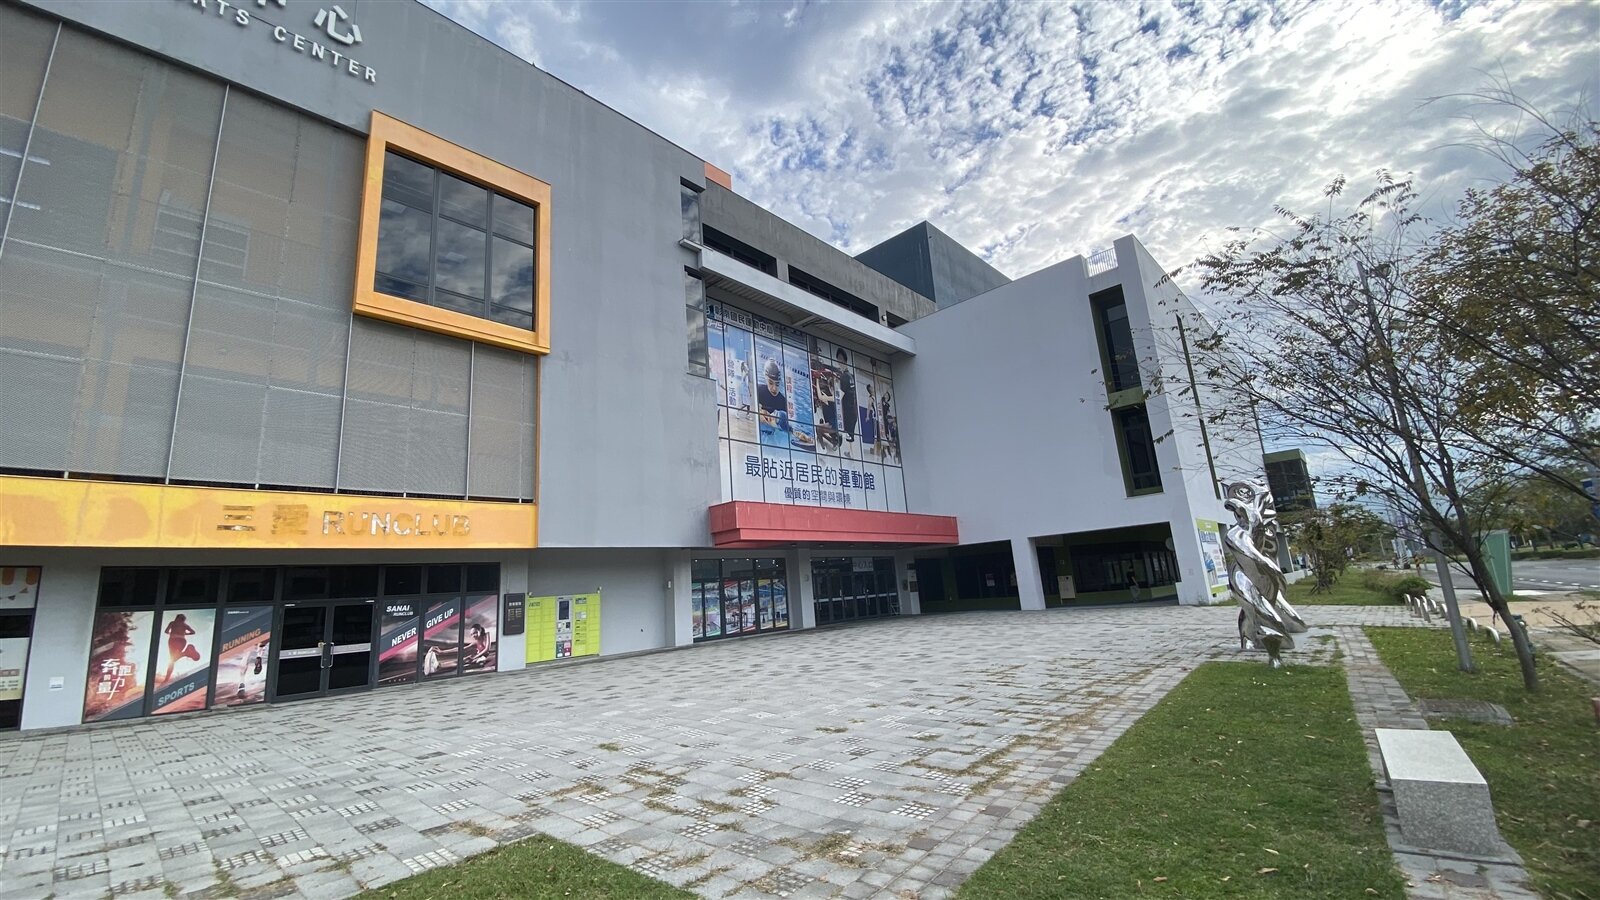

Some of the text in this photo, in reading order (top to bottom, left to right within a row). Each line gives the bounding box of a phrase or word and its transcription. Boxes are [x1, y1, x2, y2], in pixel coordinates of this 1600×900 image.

[274, 26, 376, 83] CENTER
[745, 455, 875, 490] 最貼近居民的運動館
[323, 510, 471, 537] RUNCLUB
[223, 628, 261, 651] RUNNING
[391, 608, 454, 647] NEVER GIVE UP
[158, 682, 195, 706] SPORTS
